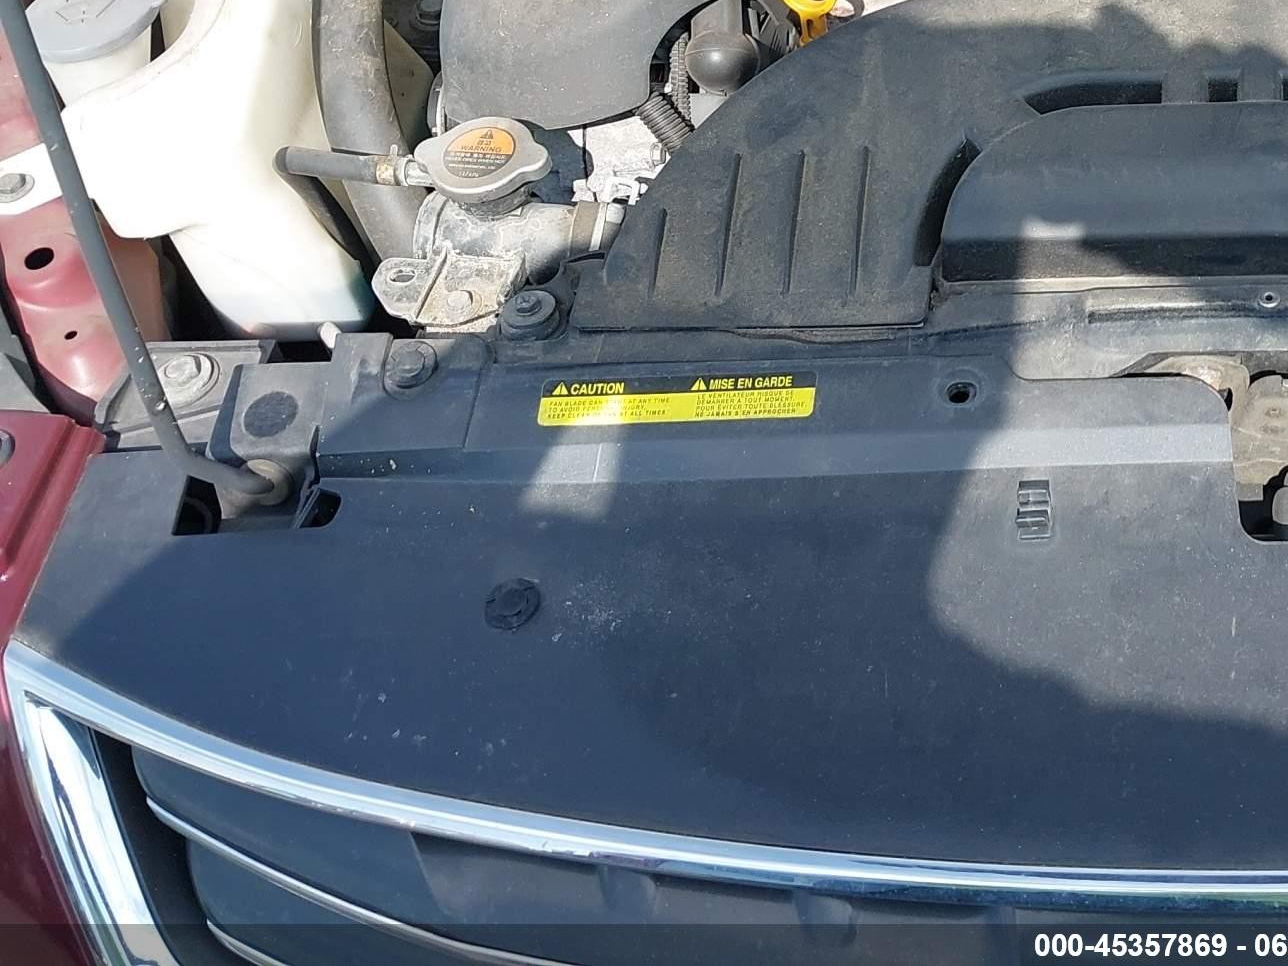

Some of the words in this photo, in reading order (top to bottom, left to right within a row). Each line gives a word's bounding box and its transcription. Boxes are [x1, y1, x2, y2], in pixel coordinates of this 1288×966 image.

[570, 381, 625, 396] CAUTION
[708, 377, 735, 390] MISE
[737, 377, 753, 389] EN
[754, 375, 793, 388] GARDE
